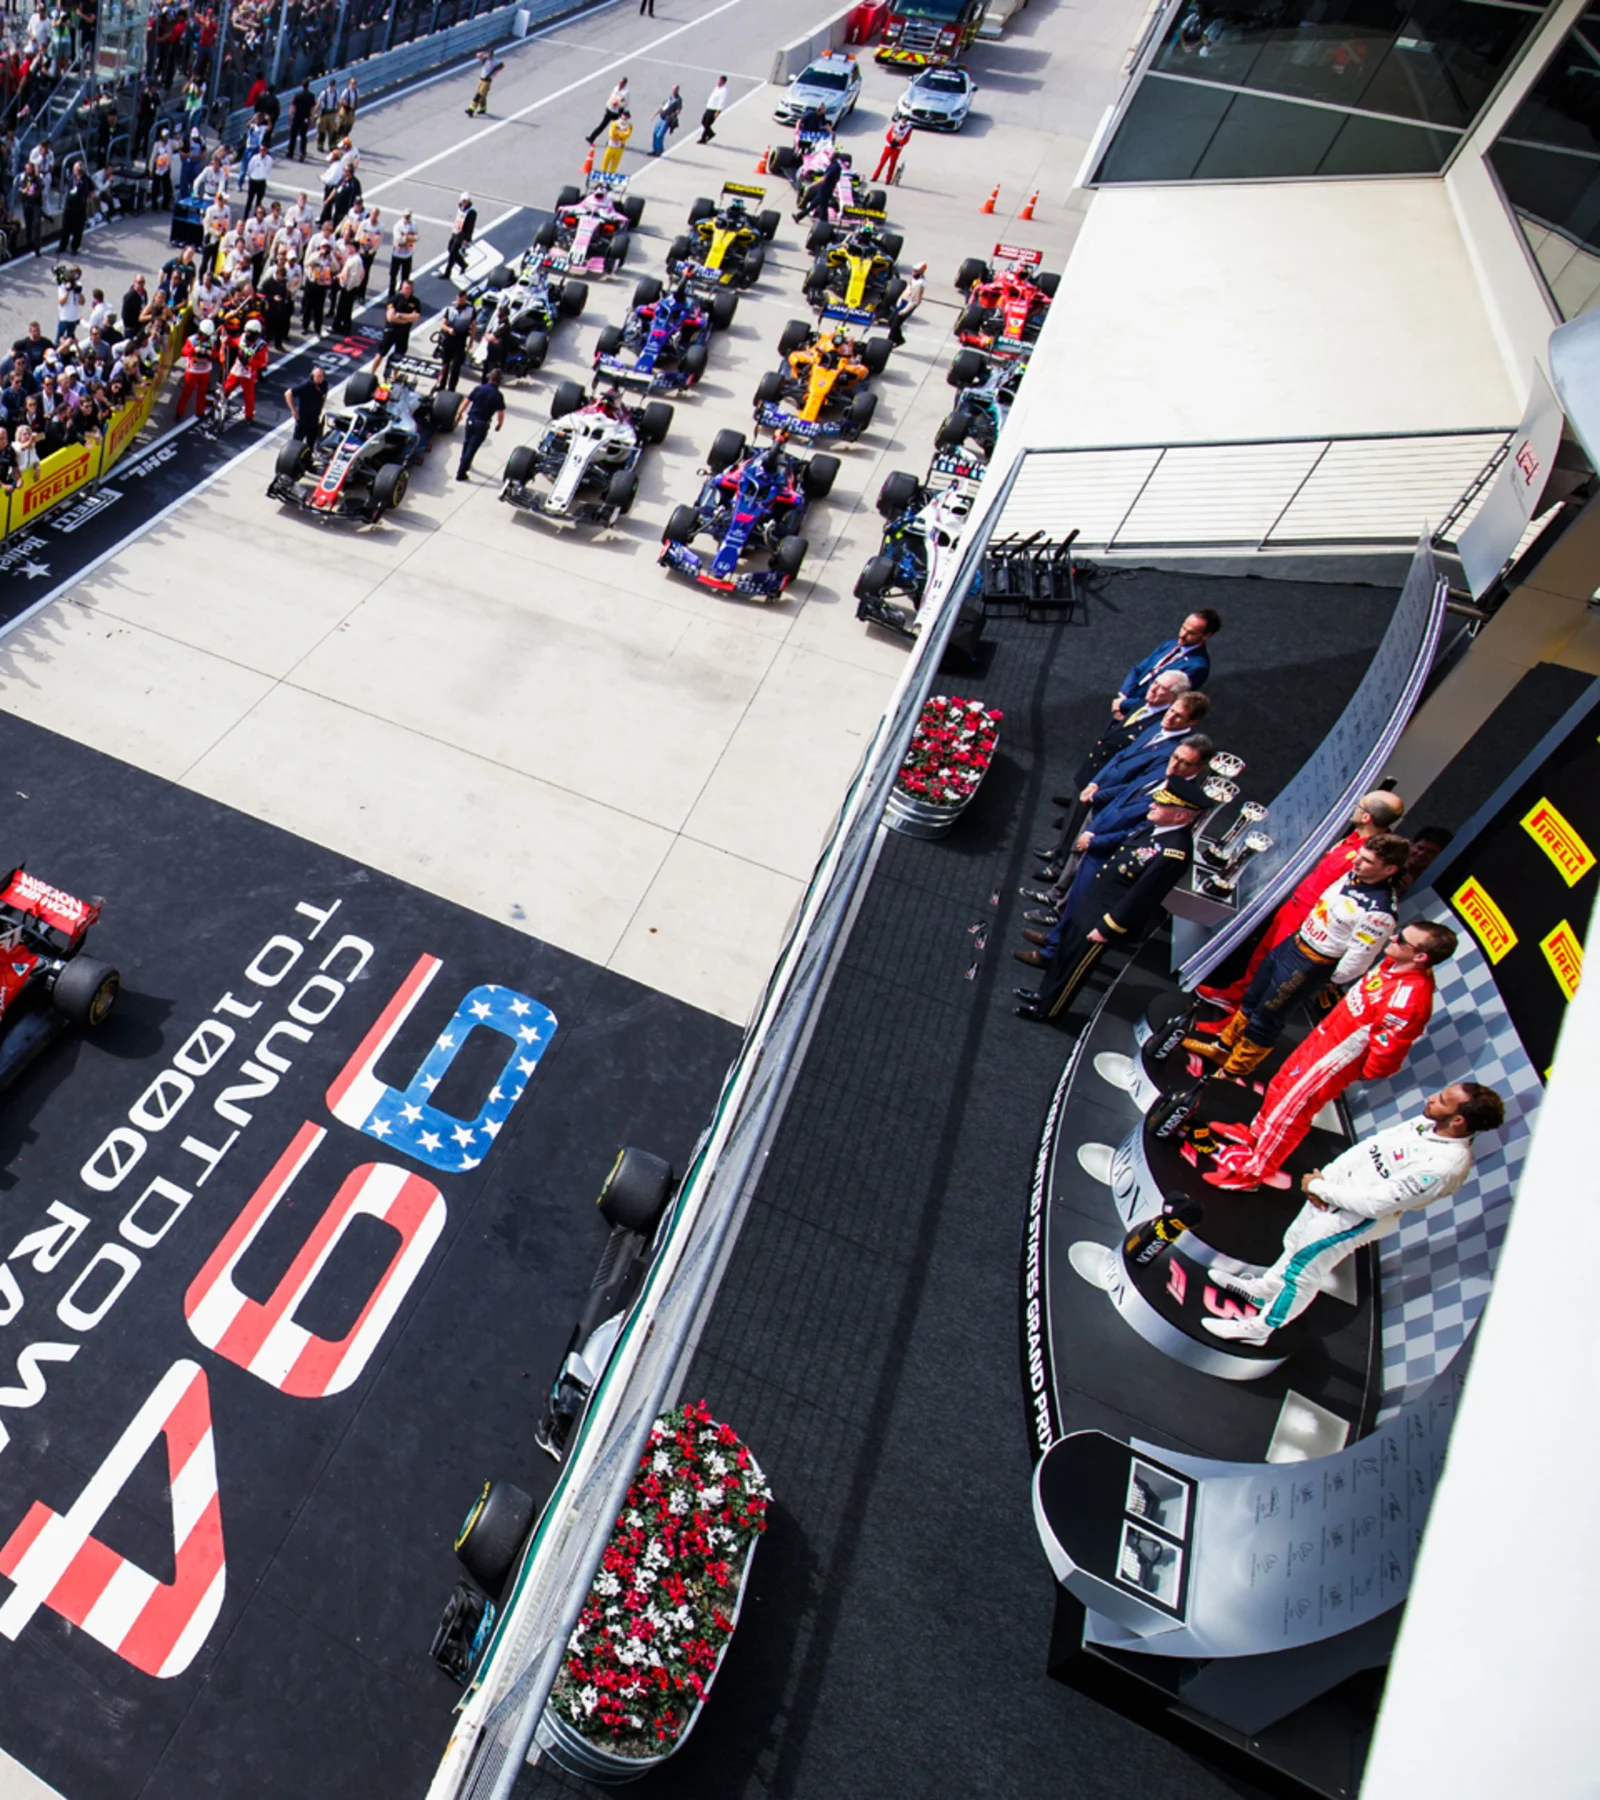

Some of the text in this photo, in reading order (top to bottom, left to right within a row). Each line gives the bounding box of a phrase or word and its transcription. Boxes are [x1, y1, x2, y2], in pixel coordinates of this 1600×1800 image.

[23, 452, 90, 515] PIRELLI
[938, 453, 987, 470] MARTIN
[1530, 808, 1586, 875] PIRELLI
[246, 898, 341, 988] TO
[1459, 886, 1510, 953] PIRELLI
[1548, 931, 1583, 998] PIREL
[80, 990, 262, 1194] 1000
[1026, 1214, 1042, 1300] STATES
[1026, 1298, 1045, 1393] GRAND
